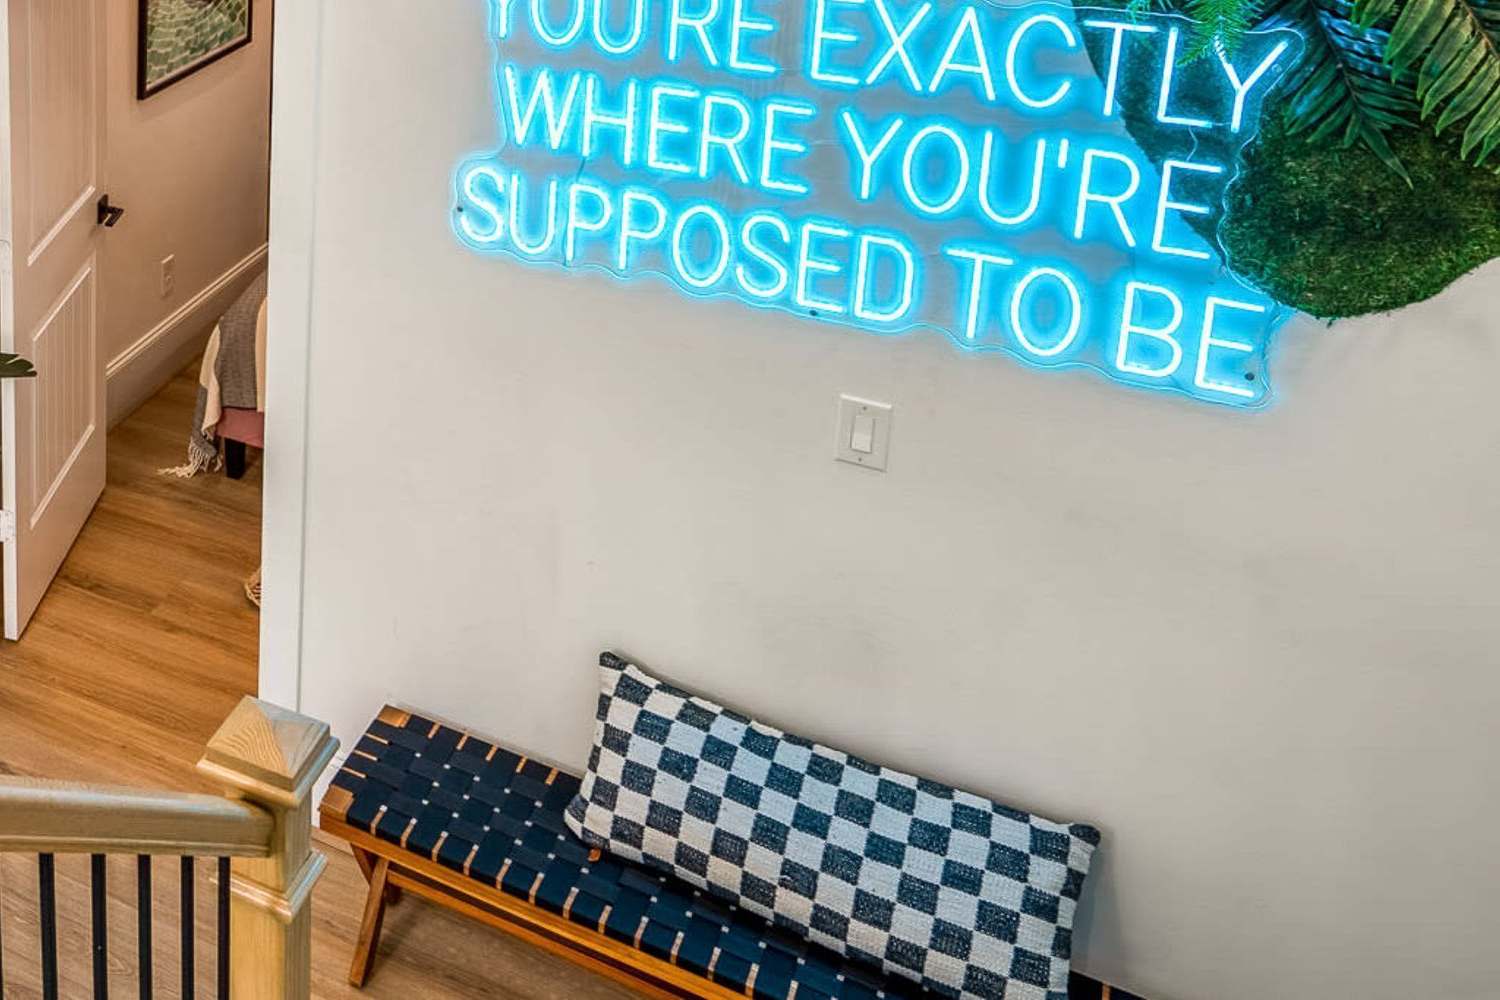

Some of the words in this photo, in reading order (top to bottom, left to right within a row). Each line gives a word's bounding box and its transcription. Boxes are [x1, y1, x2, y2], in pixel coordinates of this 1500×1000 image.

[503, 64, 815, 195] WHERE
[841, 109, 1223, 261] YOU'RE
[459, 166, 915, 323] SUPPOSED
[947, 246, 1082, 356] TO
[1115, 281, 1267, 399] BE
